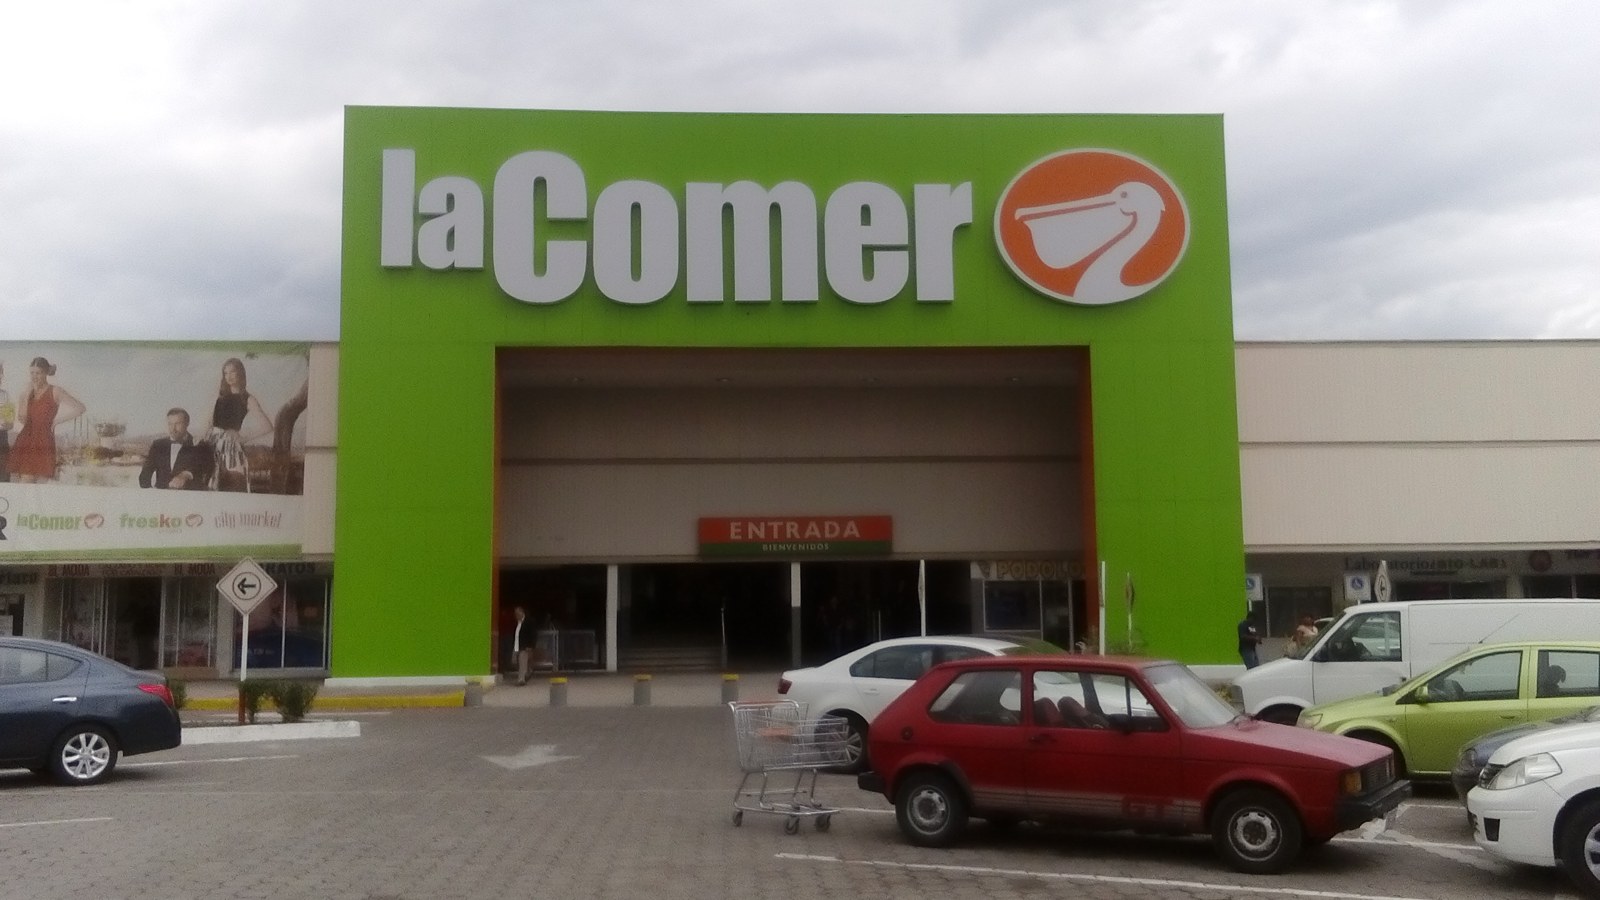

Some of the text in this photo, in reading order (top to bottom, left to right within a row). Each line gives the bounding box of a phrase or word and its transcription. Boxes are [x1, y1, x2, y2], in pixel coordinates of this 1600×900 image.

[119, 513, 181, 528] fresko
[730, 520, 860, 540] ENTRADA
[761, 542, 830, 552] BIENVENIDOS
[261, 561, 316, 575] RATOS
